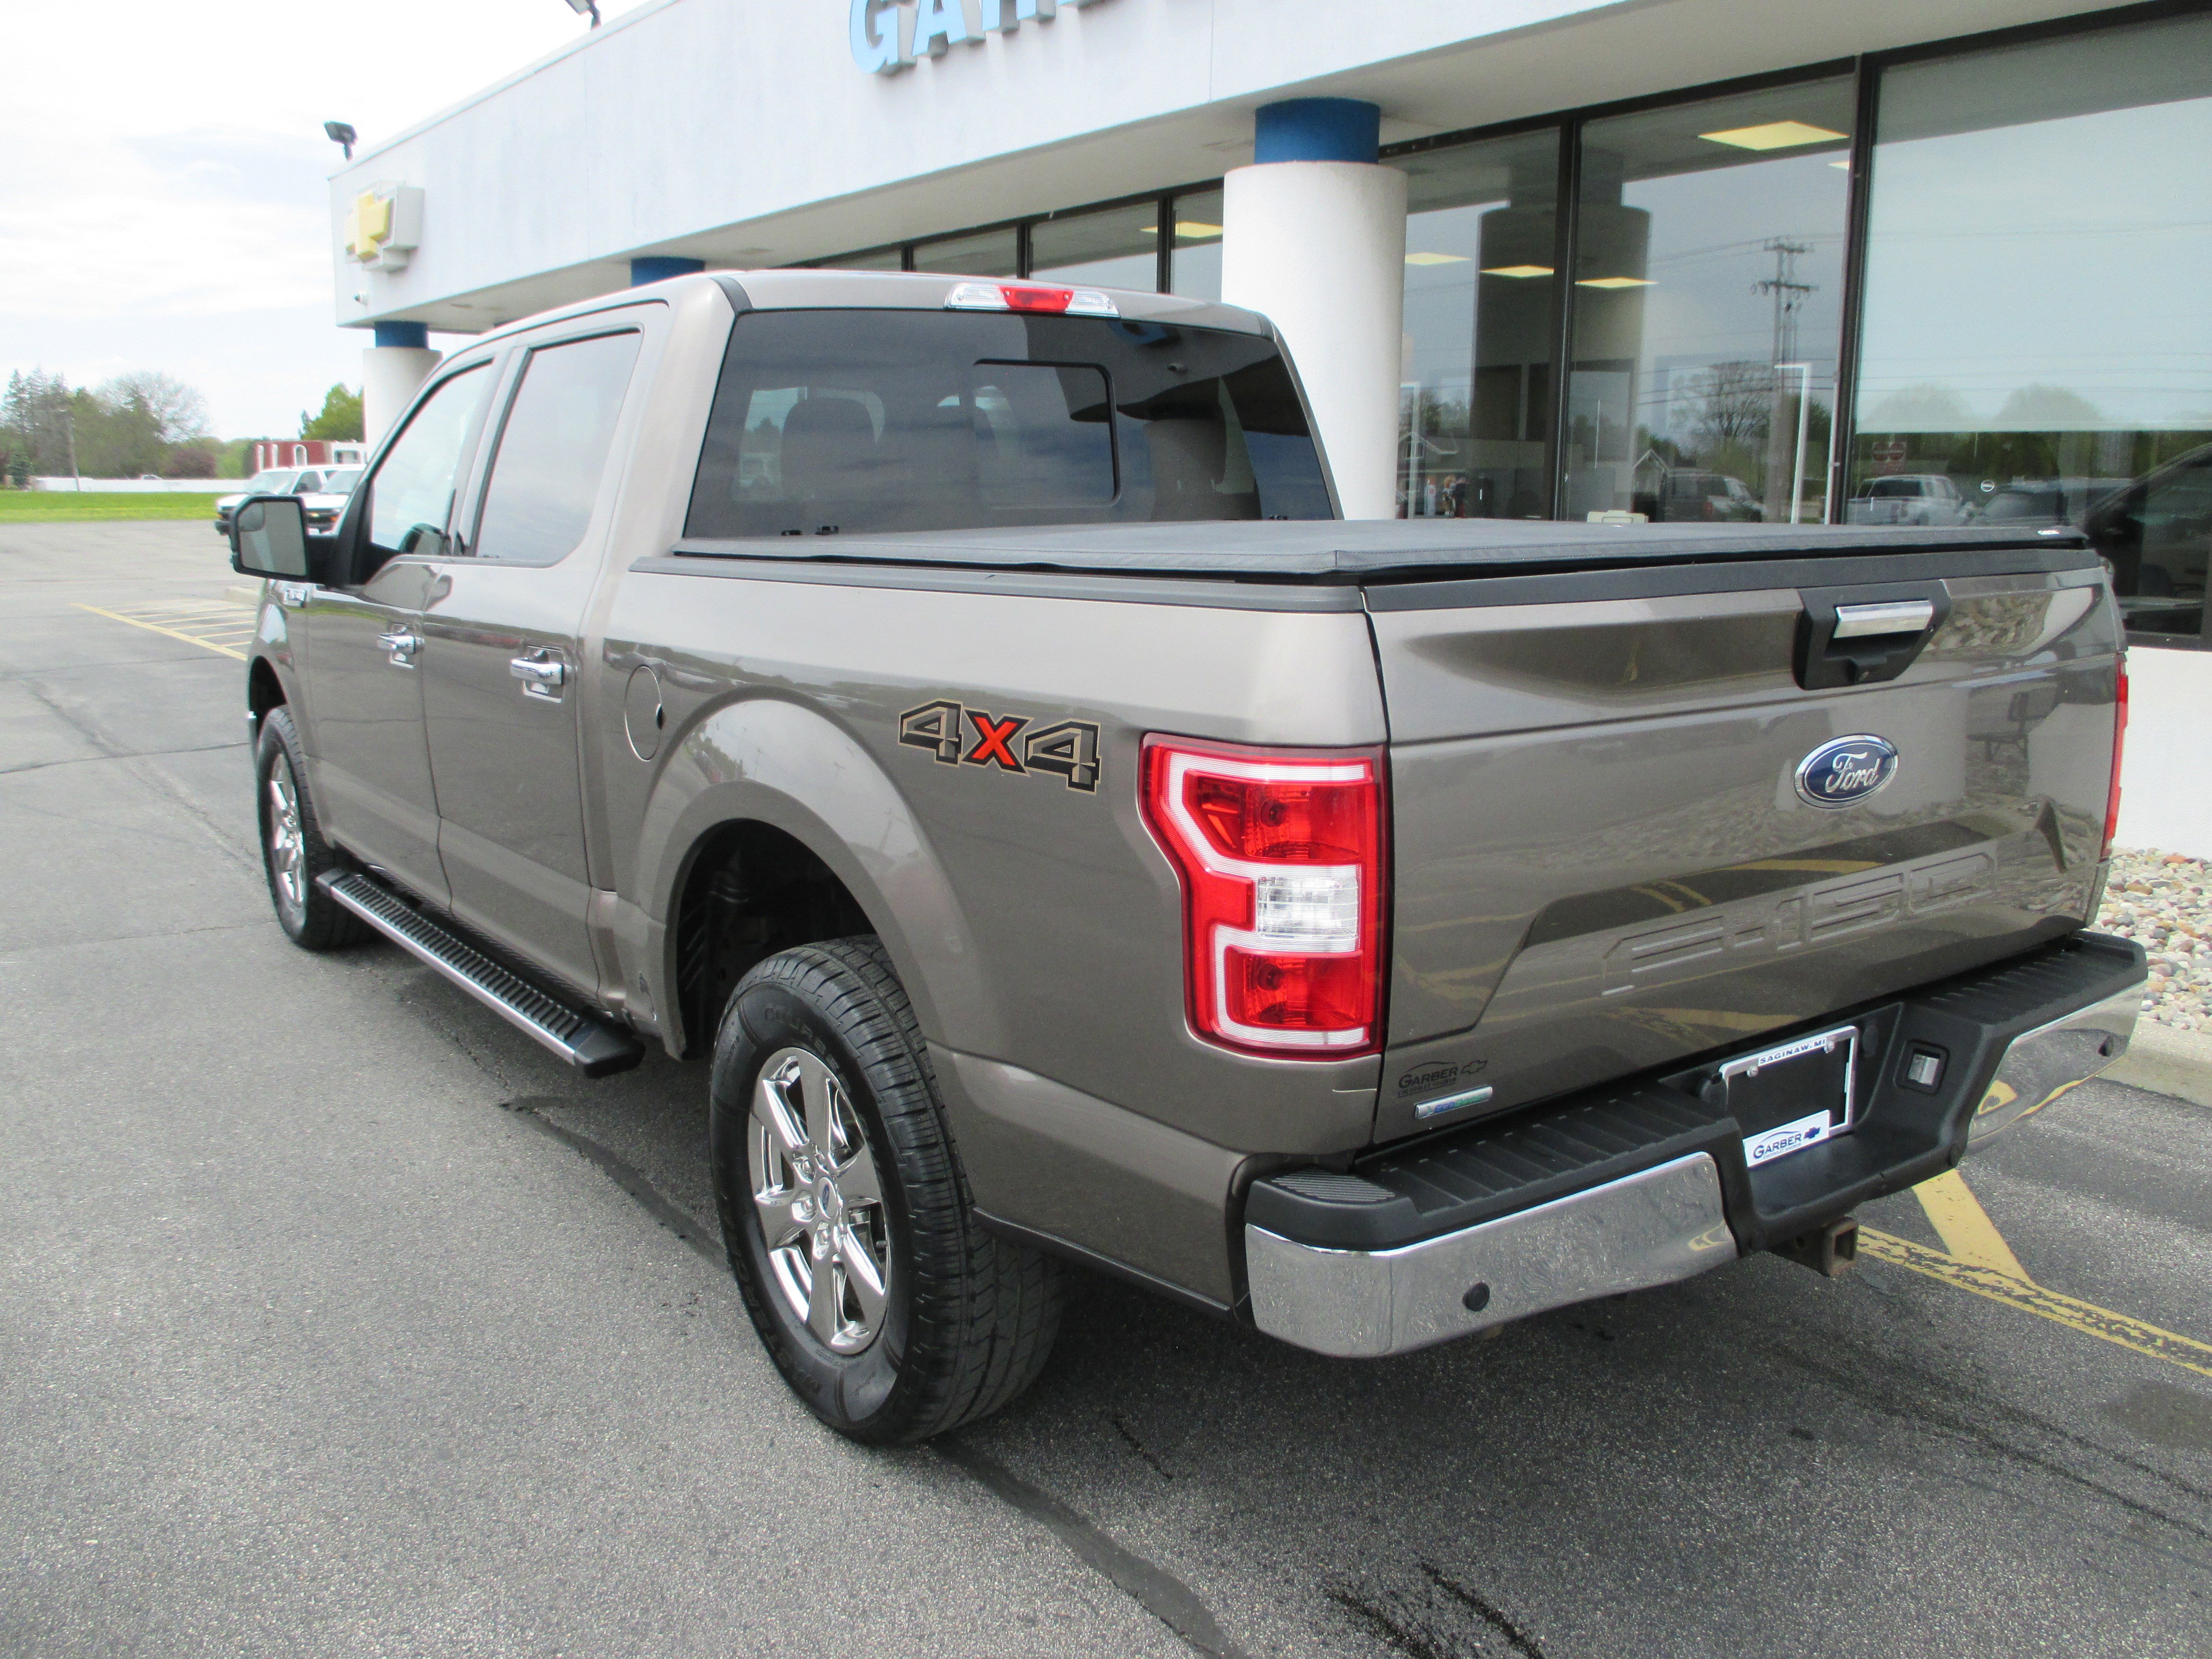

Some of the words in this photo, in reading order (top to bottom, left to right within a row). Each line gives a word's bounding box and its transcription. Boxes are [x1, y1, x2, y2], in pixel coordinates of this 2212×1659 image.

[1825, 751, 1881, 793] Ford
[1398, 1066, 1458, 1089] GARBER
[1753, 1133, 1802, 1159] GARBER
